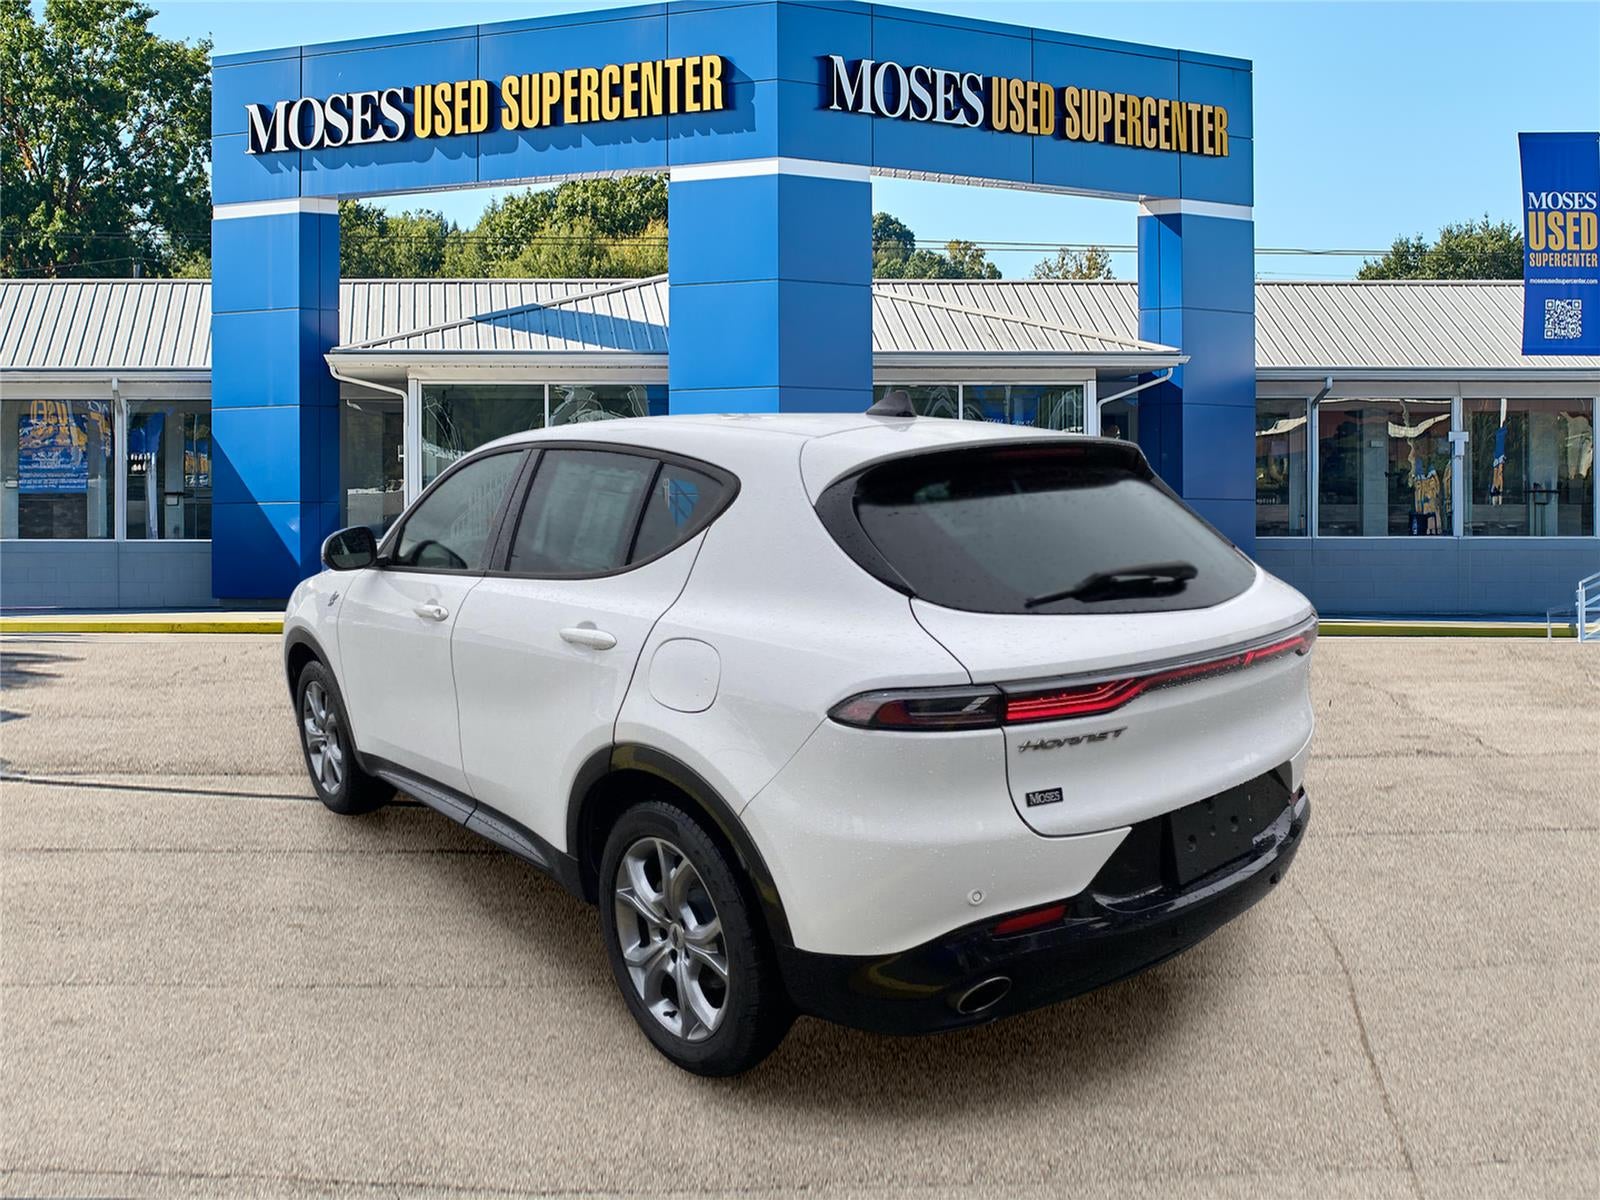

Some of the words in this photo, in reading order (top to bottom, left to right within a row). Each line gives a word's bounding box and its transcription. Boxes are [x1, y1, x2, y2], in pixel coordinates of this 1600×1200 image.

[244, 87, 408, 155] MOSES
[413, 79, 489, 139] USED
[500, 54, 724, 131] SUPERCENTER
[828, 54, 985, 128] MOSES
[990, 76, 1056, 136] USED
[1064, 85, 1229, 157] SUPERCENTER
[1527, 191, 1598, 210] MOSES
[1528, 211, 1598, 251] USED
[1529, 252, 1598, 268] SUPERCENTER
